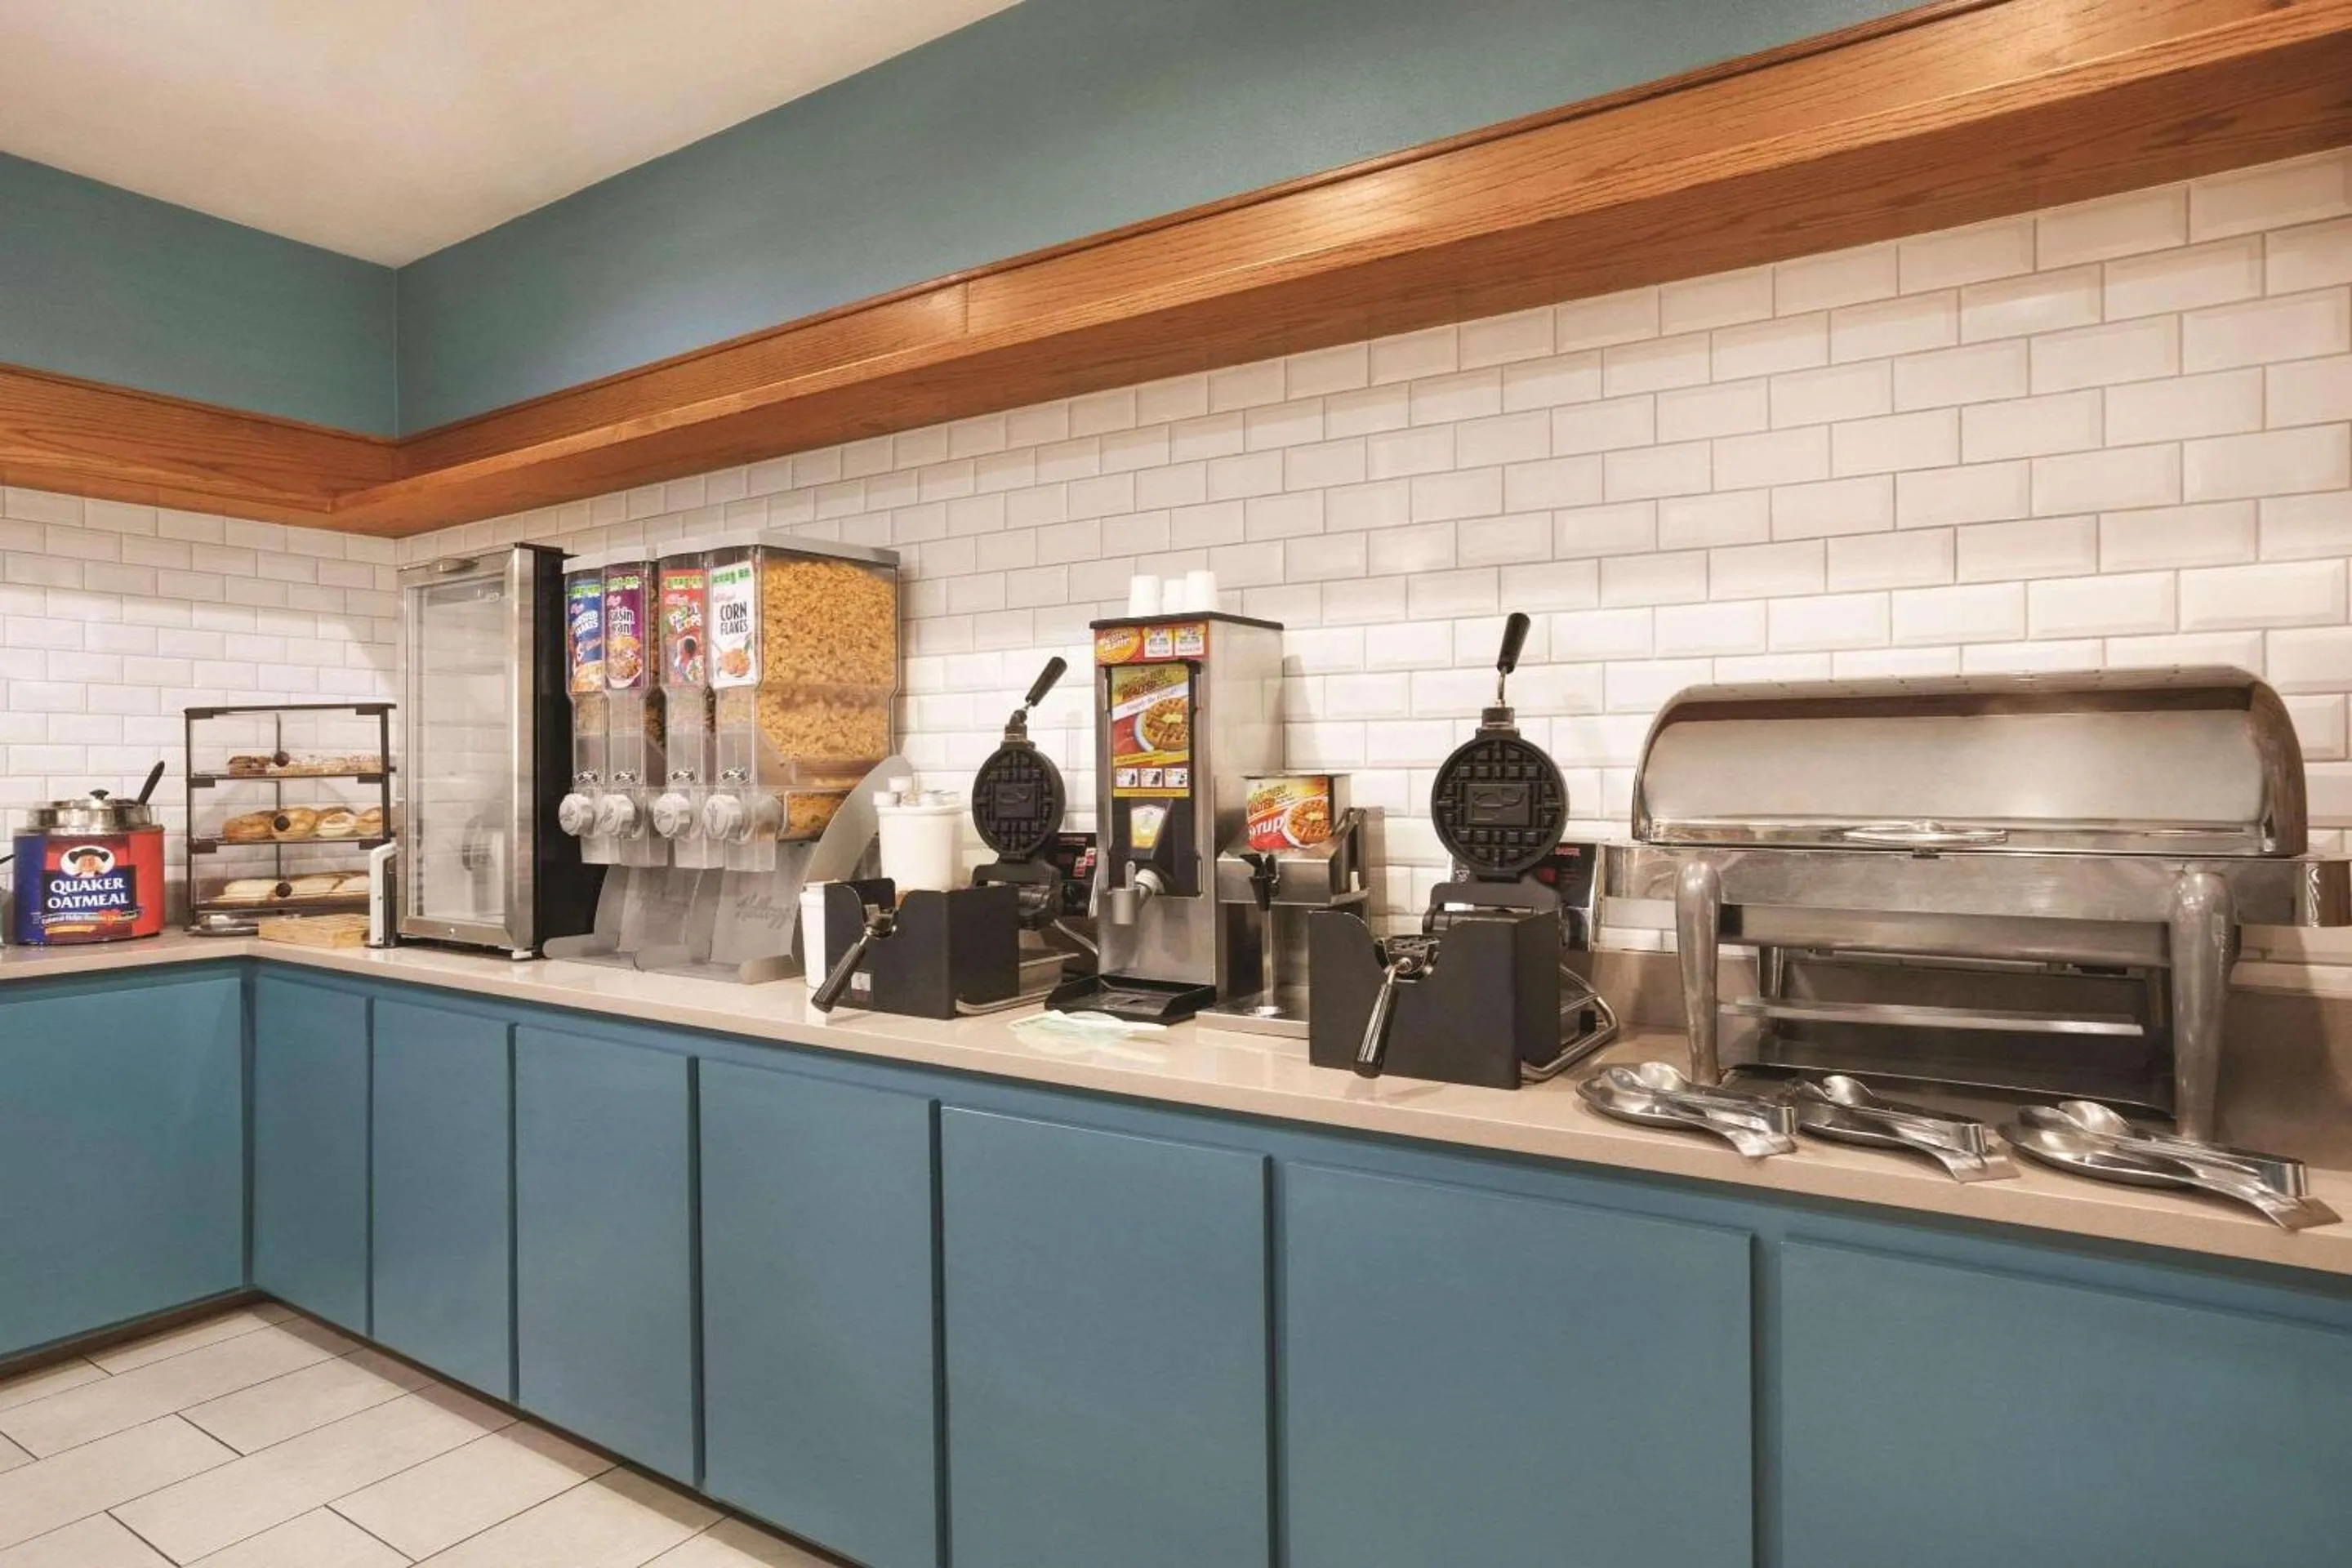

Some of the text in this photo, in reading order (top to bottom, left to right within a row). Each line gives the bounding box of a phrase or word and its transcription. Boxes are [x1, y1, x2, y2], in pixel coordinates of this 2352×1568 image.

[720, 602, 747, 621] CORN
[720, 620, 748, 636] FLAKES
[1249, 816, 1285, 842] yrup
[50, 877, 126, 895] QUAKER
[47, 893, 129, 909] OATMEAL
